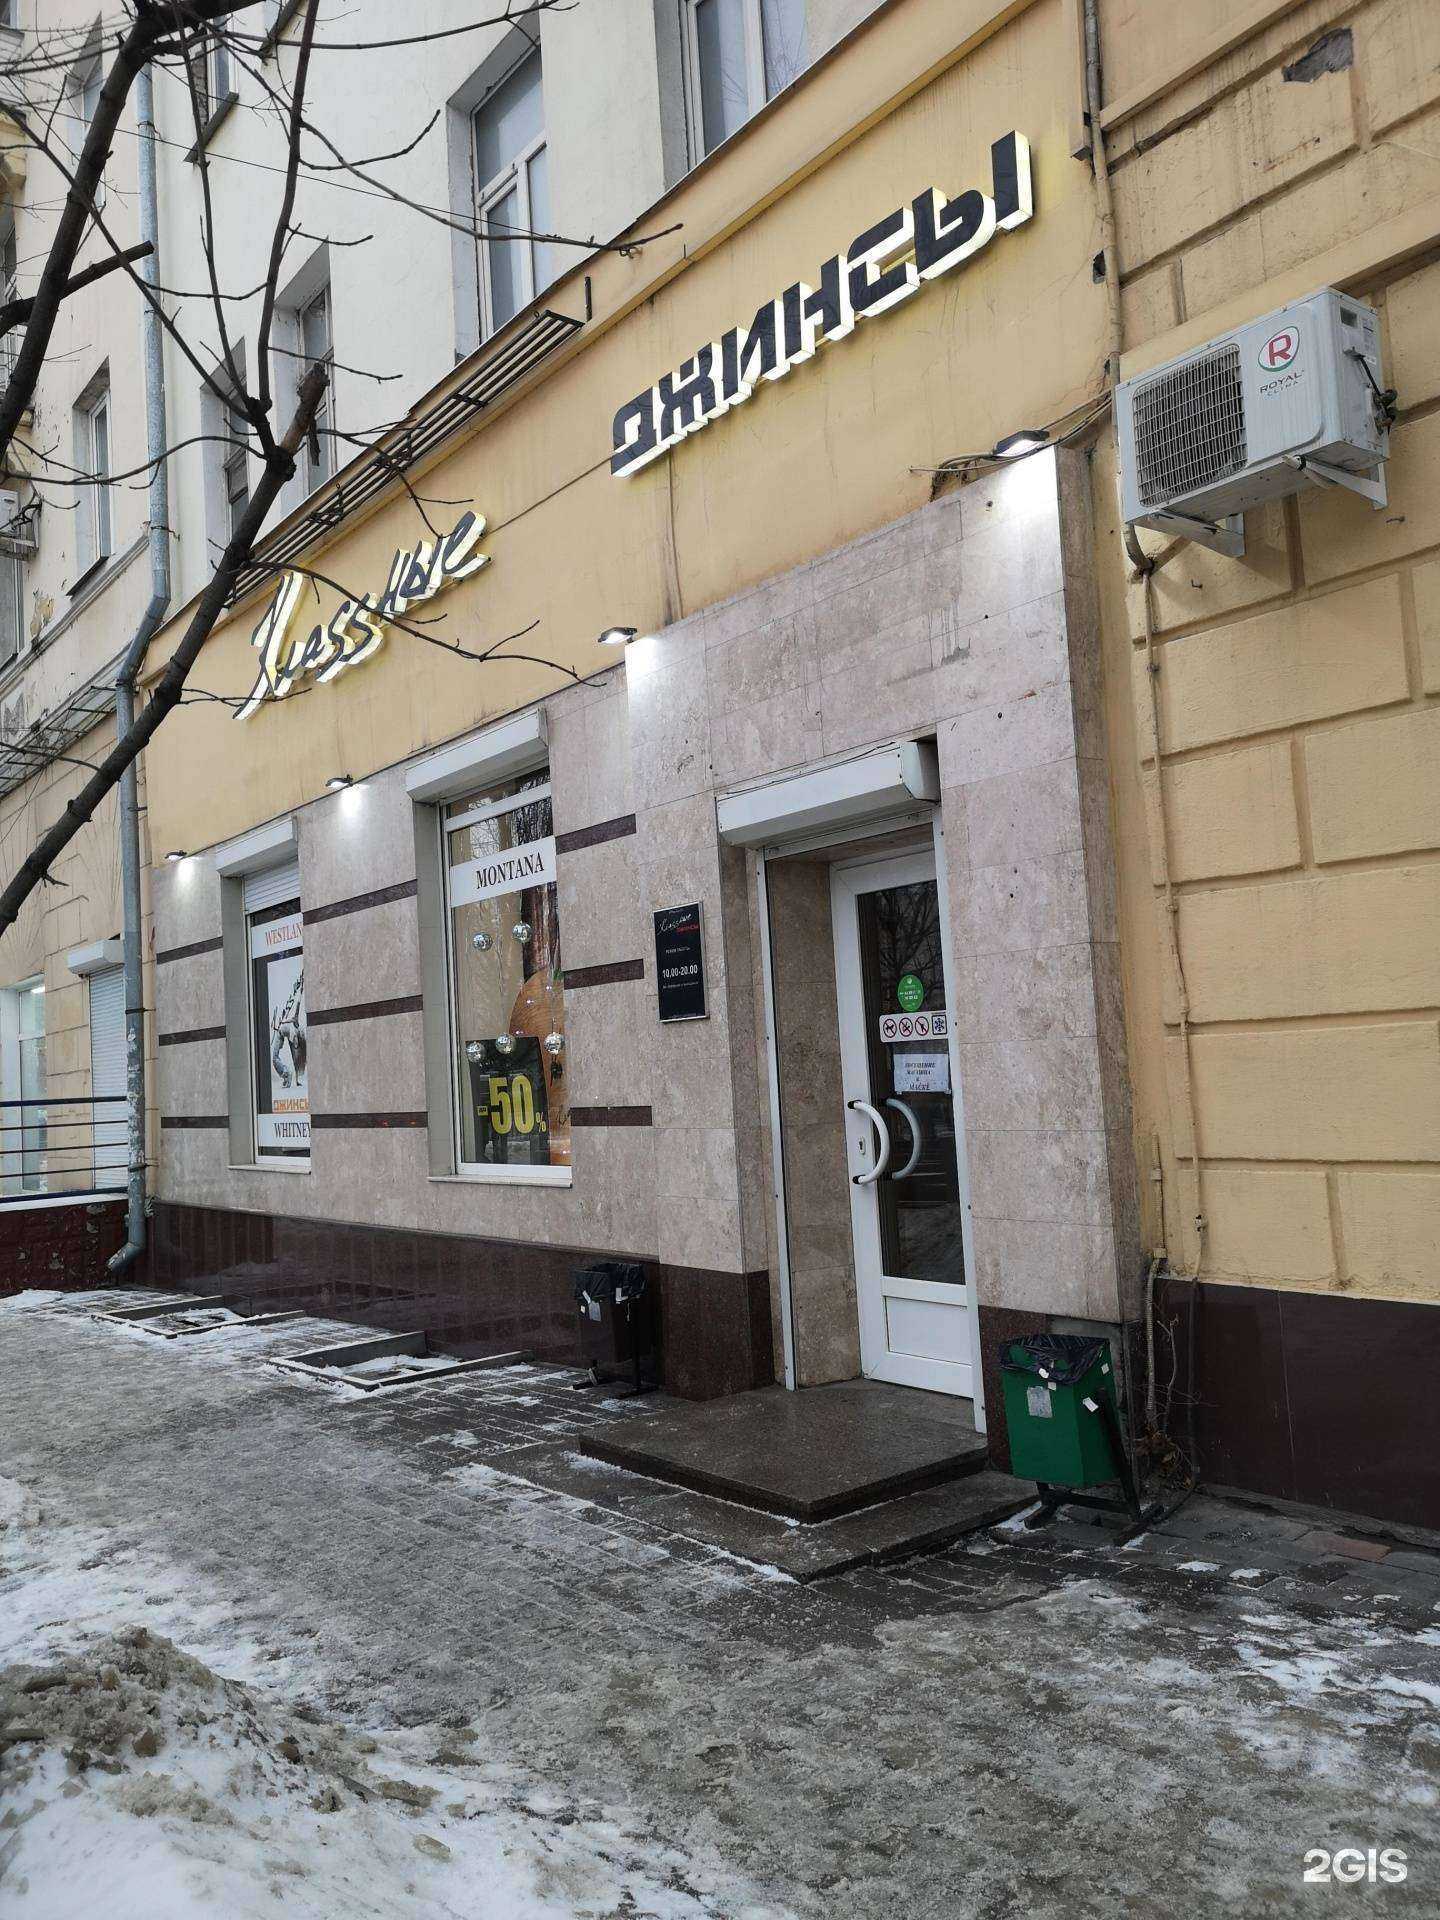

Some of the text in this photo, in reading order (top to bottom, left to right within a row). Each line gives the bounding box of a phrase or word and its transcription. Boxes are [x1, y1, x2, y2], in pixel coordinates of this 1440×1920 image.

[611, 130, 1034, 478] ДЖИНСЫ
[1268, 334, 1292, 367] R
[1260, 371, 1303, 394] ROYAL
[476, 852, 544, 889] MONTANA
